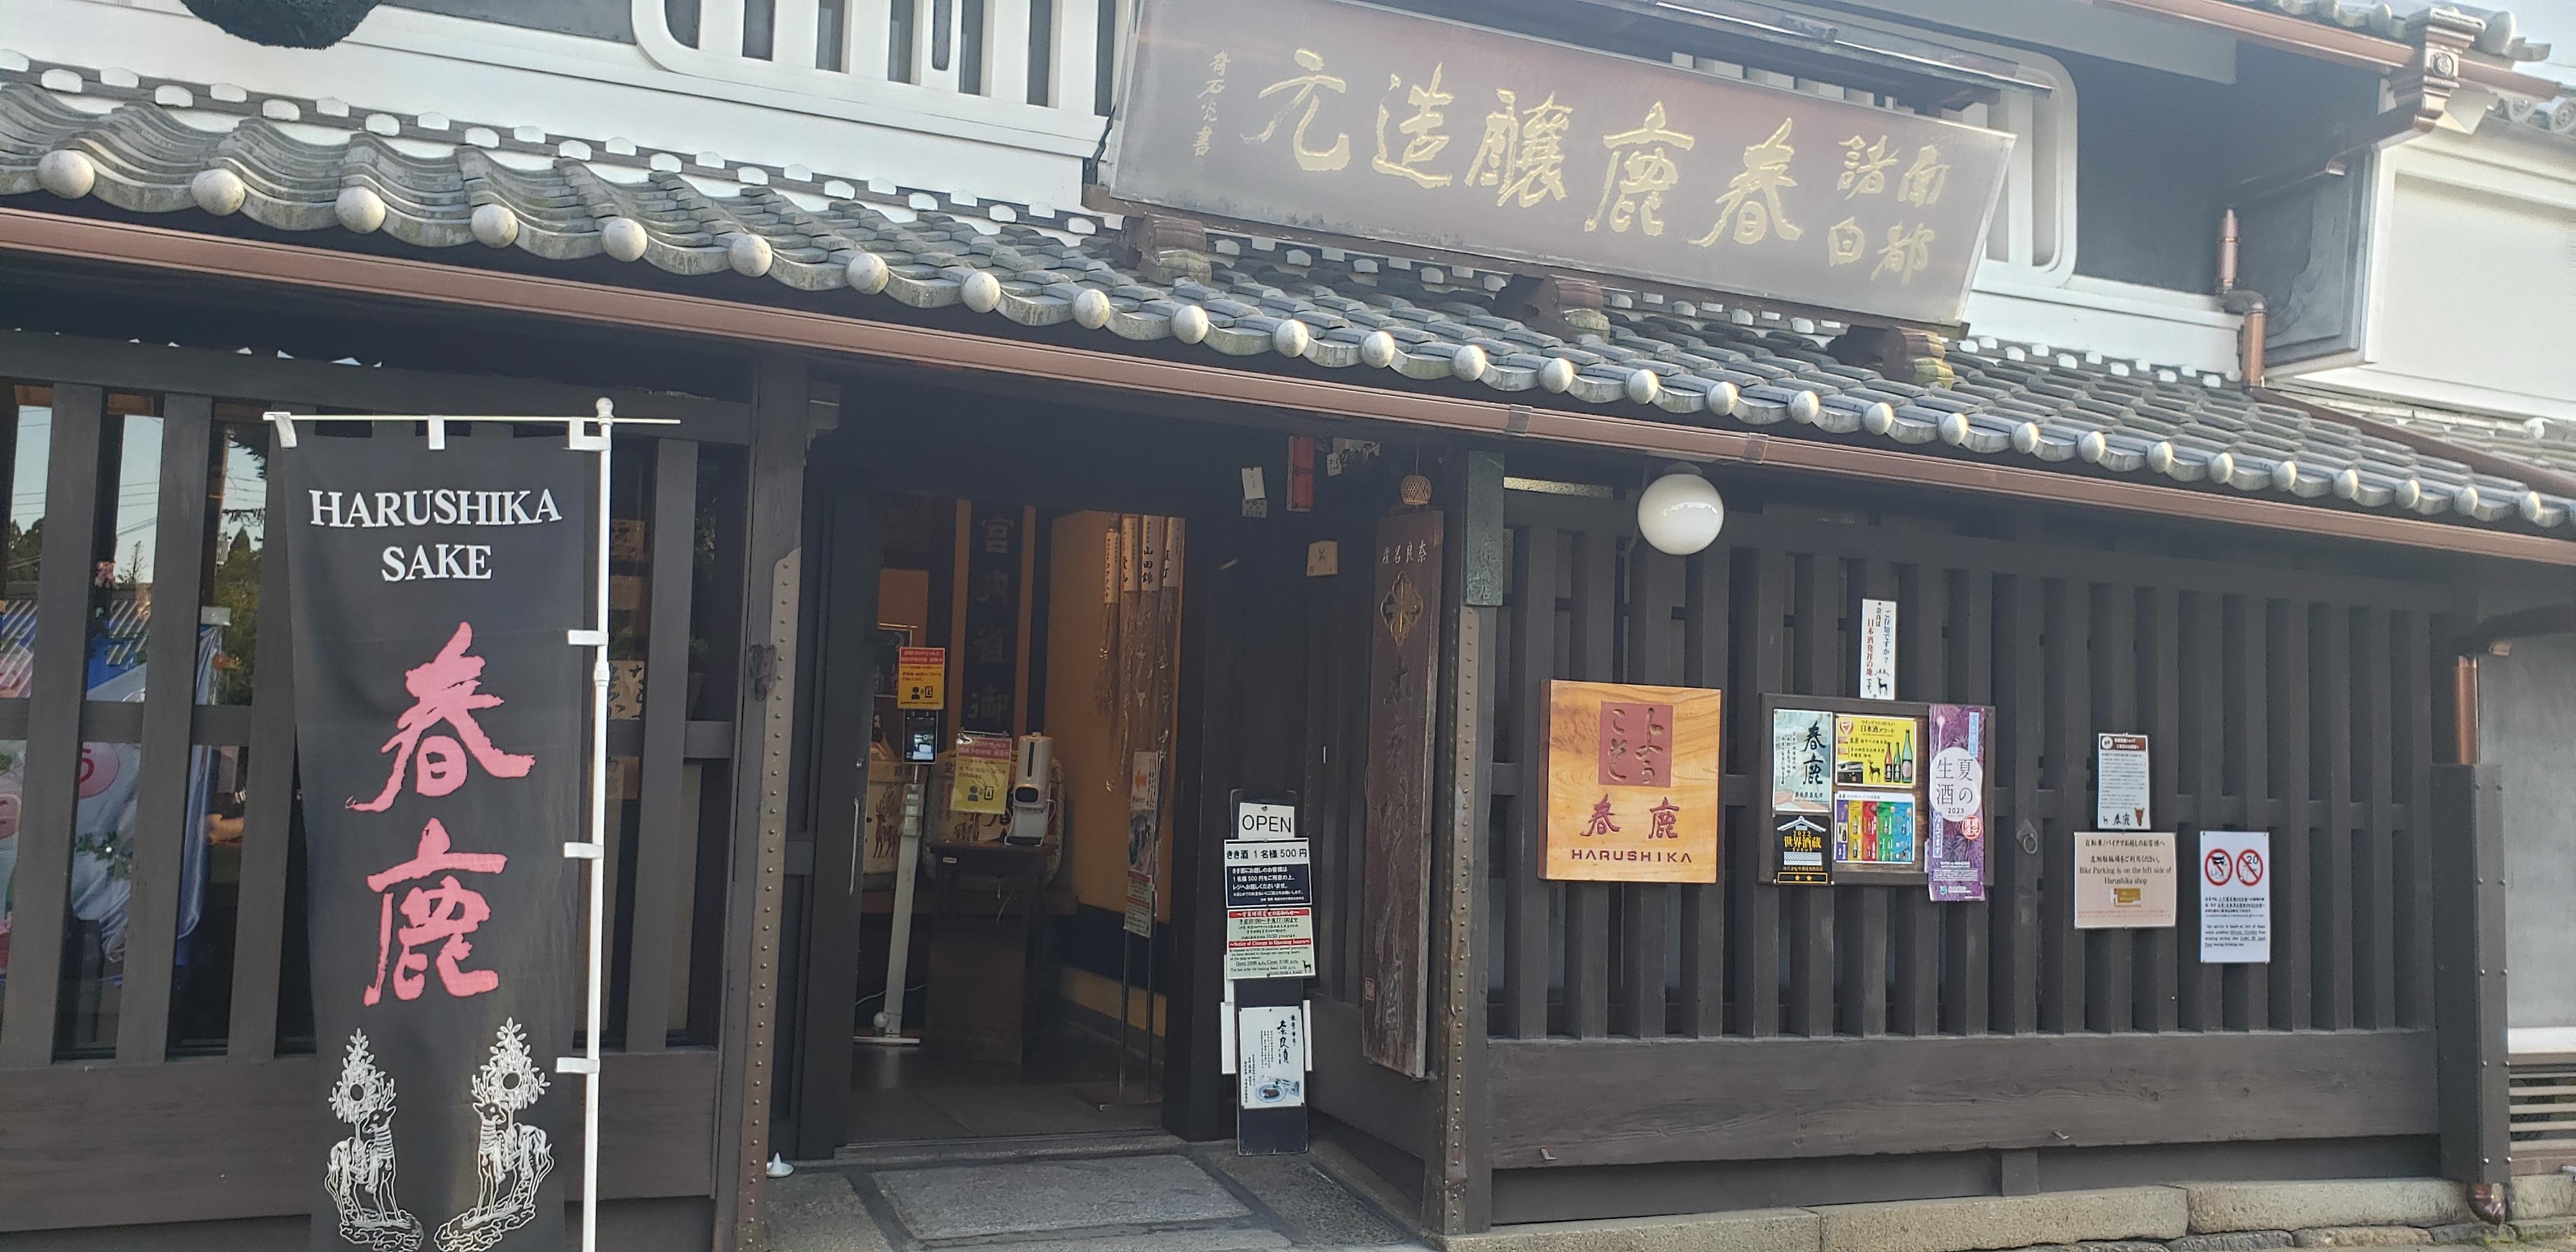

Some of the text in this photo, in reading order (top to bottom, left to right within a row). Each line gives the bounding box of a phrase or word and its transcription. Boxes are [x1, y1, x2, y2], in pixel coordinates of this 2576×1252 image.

[309, 488, 562, 527] HARUSHIKA
[382, 544, 492, 582] SAKE
[1800, 721, 1826, 784] 春鹿
[1936, 758, 1954, 805] 生酒
[1958, 758, 1974, 804] 夏の
[344, 622, 536, 1008] 春鹿
[1242, 814, 1291, 832] OPEN
[1580, 793, 1679, 839] 春鹿
[1572, 849, 1692, 864] HARUSHIKA
[2093, 867, 2114, 875] Parking
[2246, 855, 2258, 864] 20
[2134, 877, 2147, 885] shop
